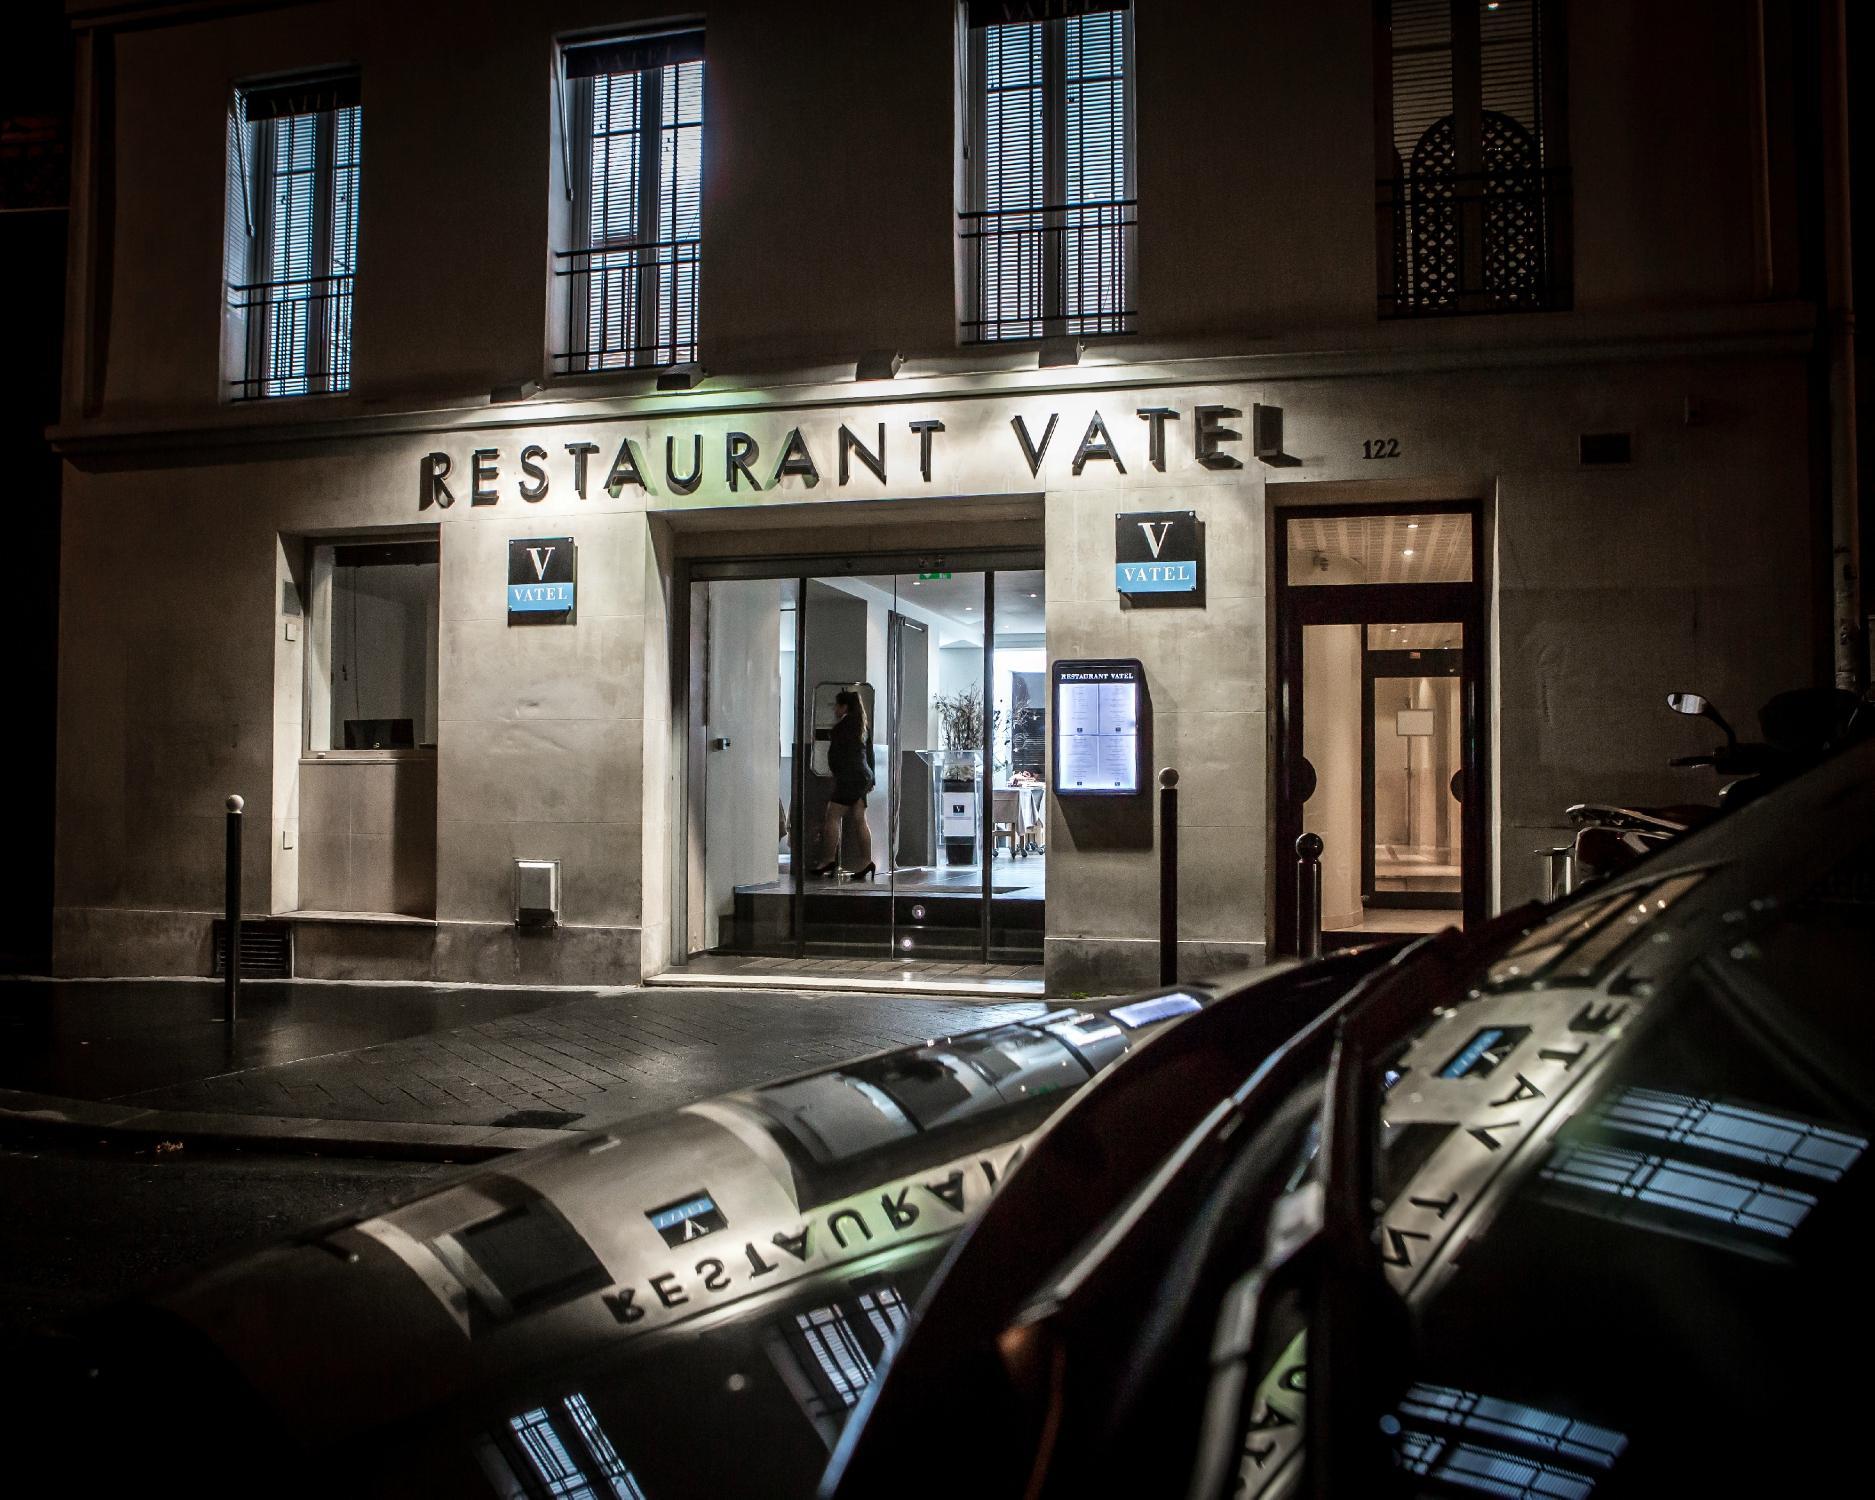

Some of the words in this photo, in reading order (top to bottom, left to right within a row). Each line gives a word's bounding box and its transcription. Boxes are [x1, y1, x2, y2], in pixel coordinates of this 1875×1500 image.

[419, 419, 946, 511] RESTAURANT
[1010, 402, 1303, 479] VATEL
[1363, 438, 1400, 460] 122
[1137, 521, 1173, 558] V
[526, 546, 556, 580] V
[1123, 565, 1190, 582] VATEL
[514, 586, 568, 602] VATEL
[1061, 673, 1109, 681] RESTAURANT
[1111, 672, 1134, 680] VATEL
